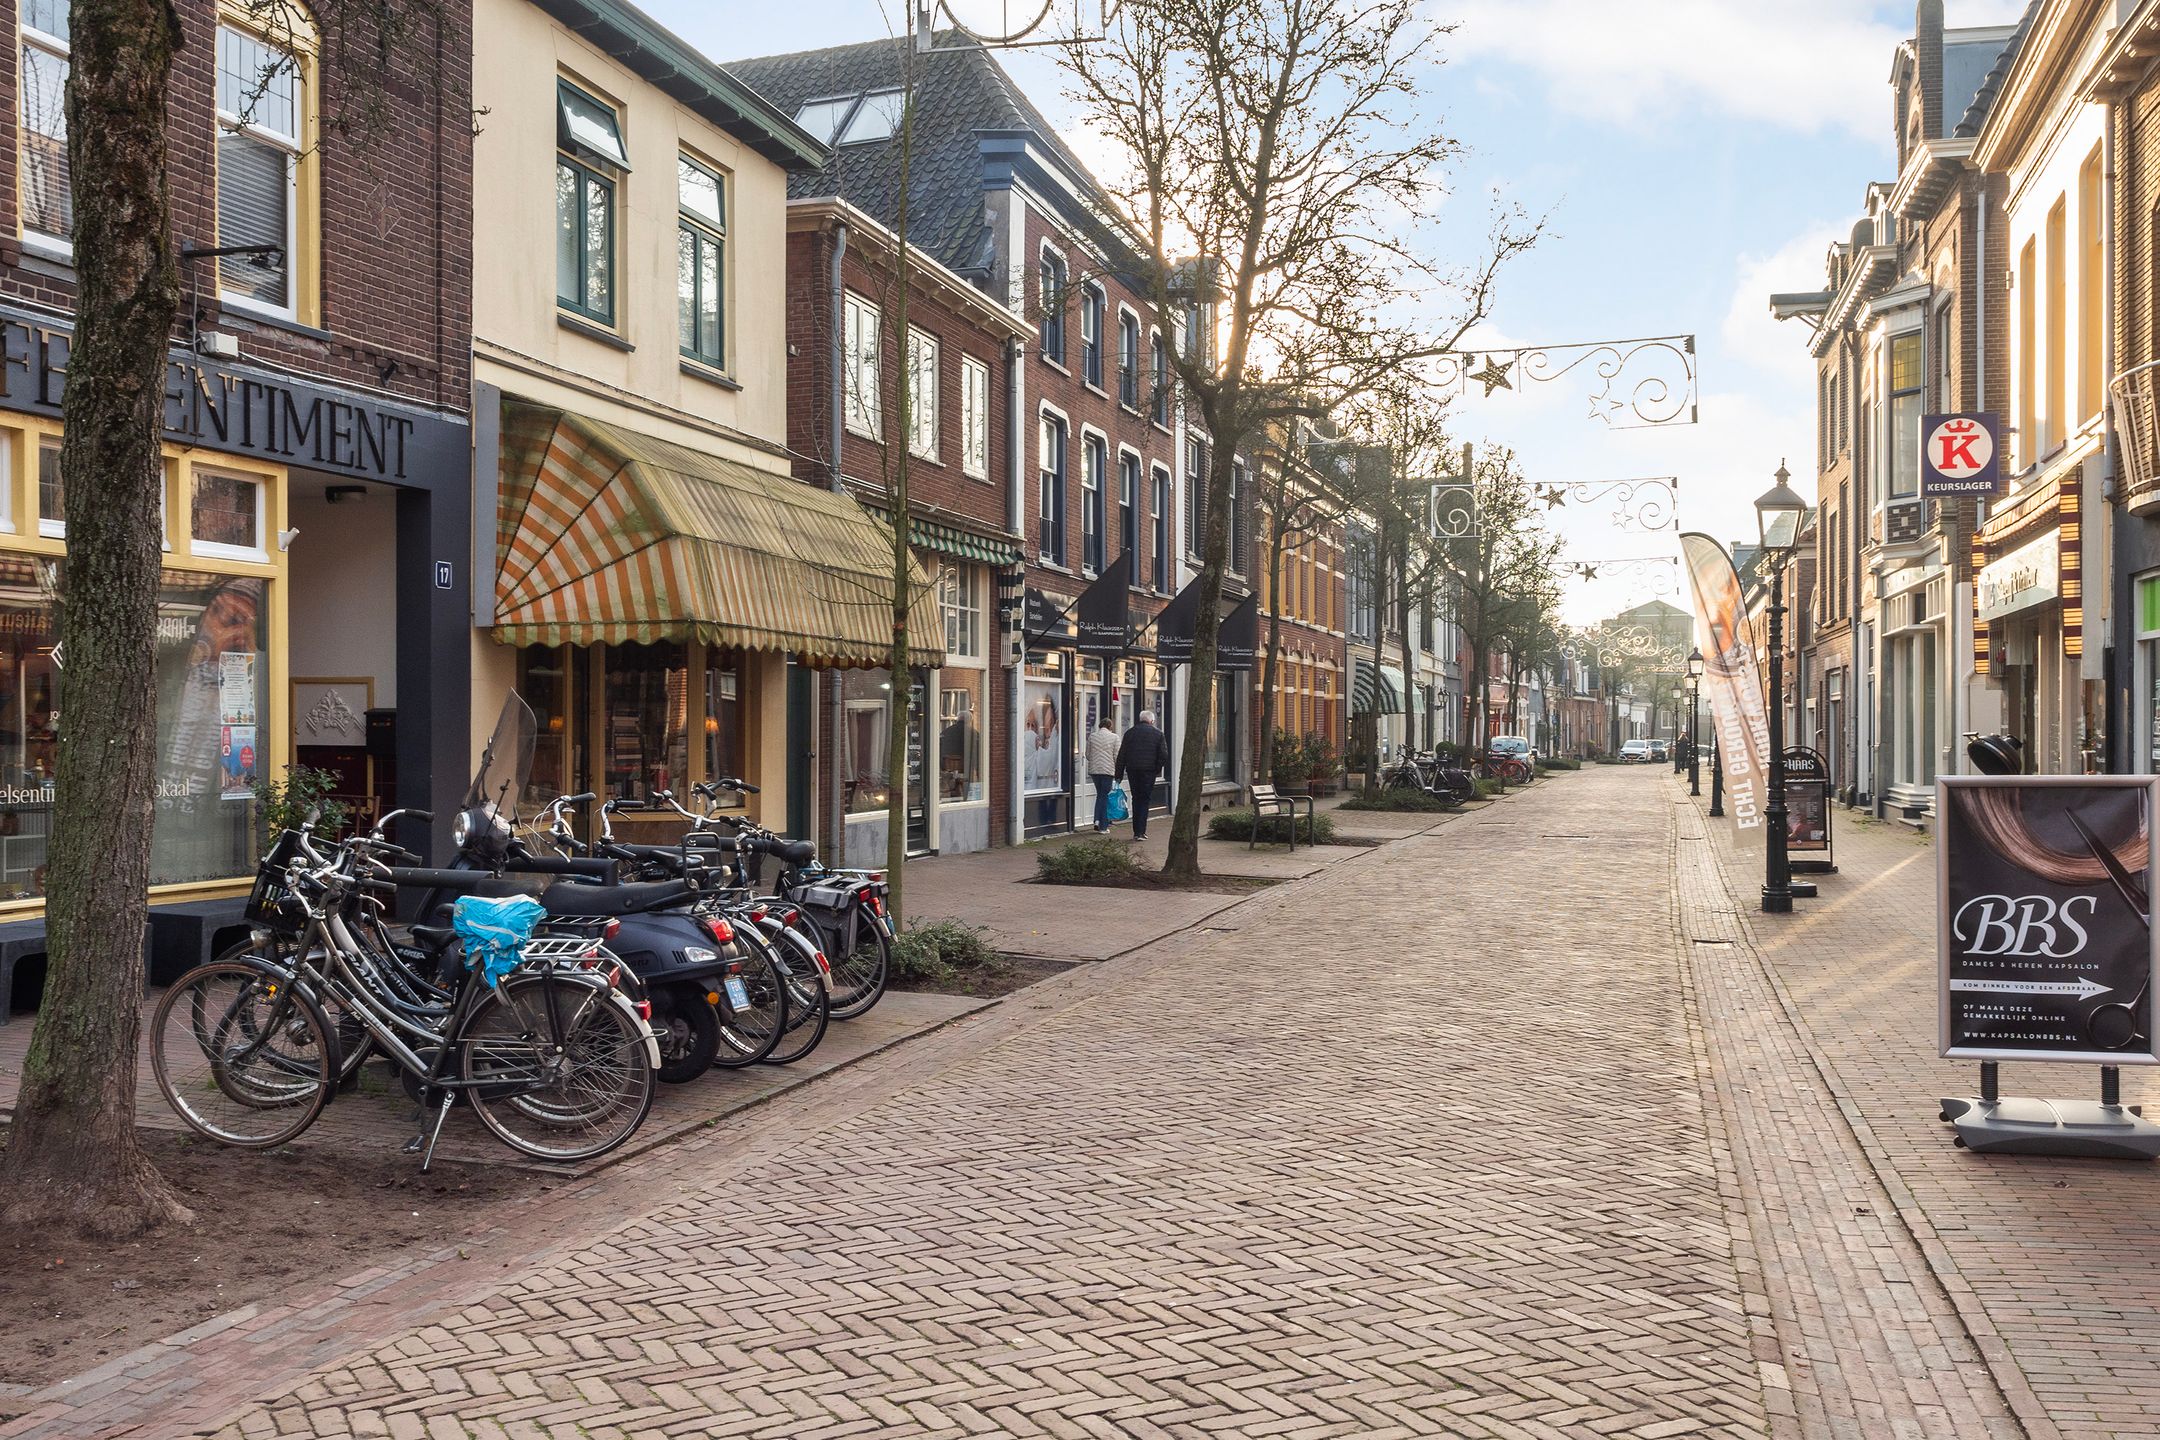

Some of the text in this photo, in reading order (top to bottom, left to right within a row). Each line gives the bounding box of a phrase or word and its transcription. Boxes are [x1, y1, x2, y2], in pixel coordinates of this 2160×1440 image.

[1938, 434, 1981, 469] K
[1927, 481, 1992, 492] KEURSLAGER
[440, 567, 449, 584] 17
[1079, 621, 1096, 632] Ralph
[1787, 758, 1815, 771] HAAS
[1953, 894, 2097, 958] BBS
[1962, 960, 1995, 968] DAMES
[345, 950, 385, 996] GIANT
[1963, 1012, 2027, 1021] GEMAKKELIJK
[1963, 1031, 2078, 1041] WWW.KAPSALONBBS.NL
